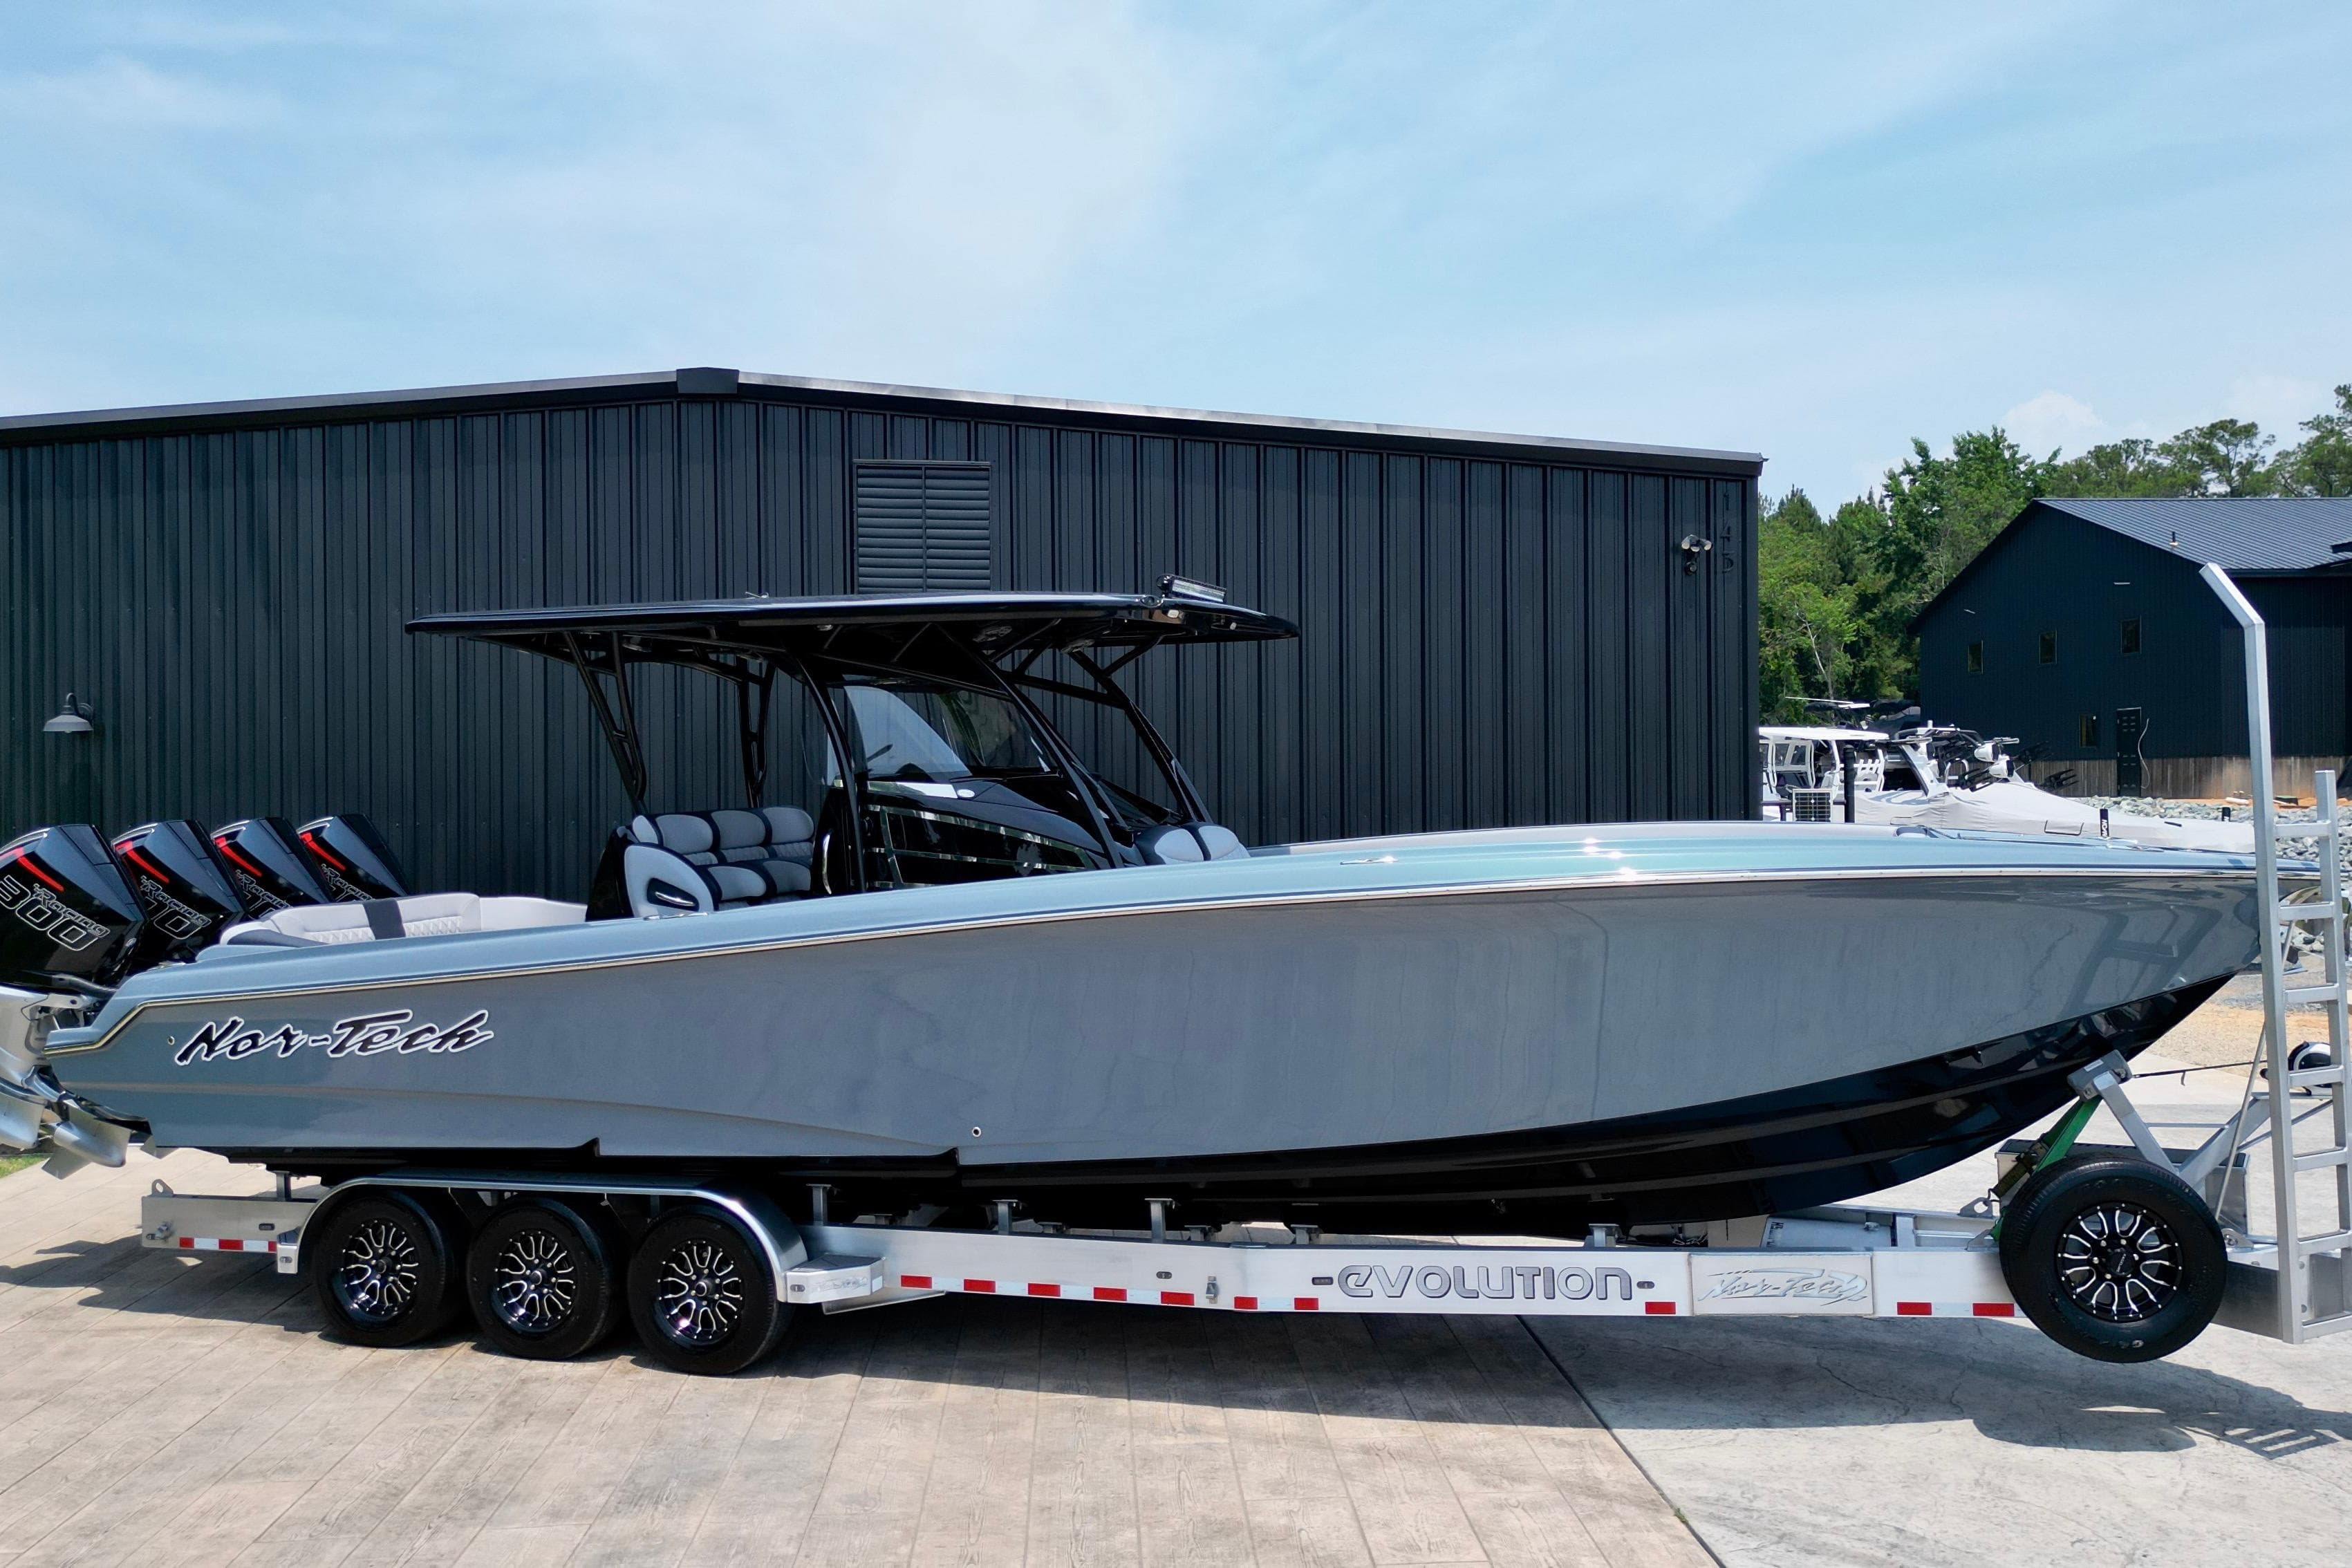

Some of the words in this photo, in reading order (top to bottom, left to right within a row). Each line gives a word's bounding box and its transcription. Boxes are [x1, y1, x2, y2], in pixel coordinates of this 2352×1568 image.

[140, 875, 212, 927] Racing
[321, 864, 375, 901] Racin
[32, 883, 111, 938] Racing
[175, 1009, 494, 1066] Nor-Tech
